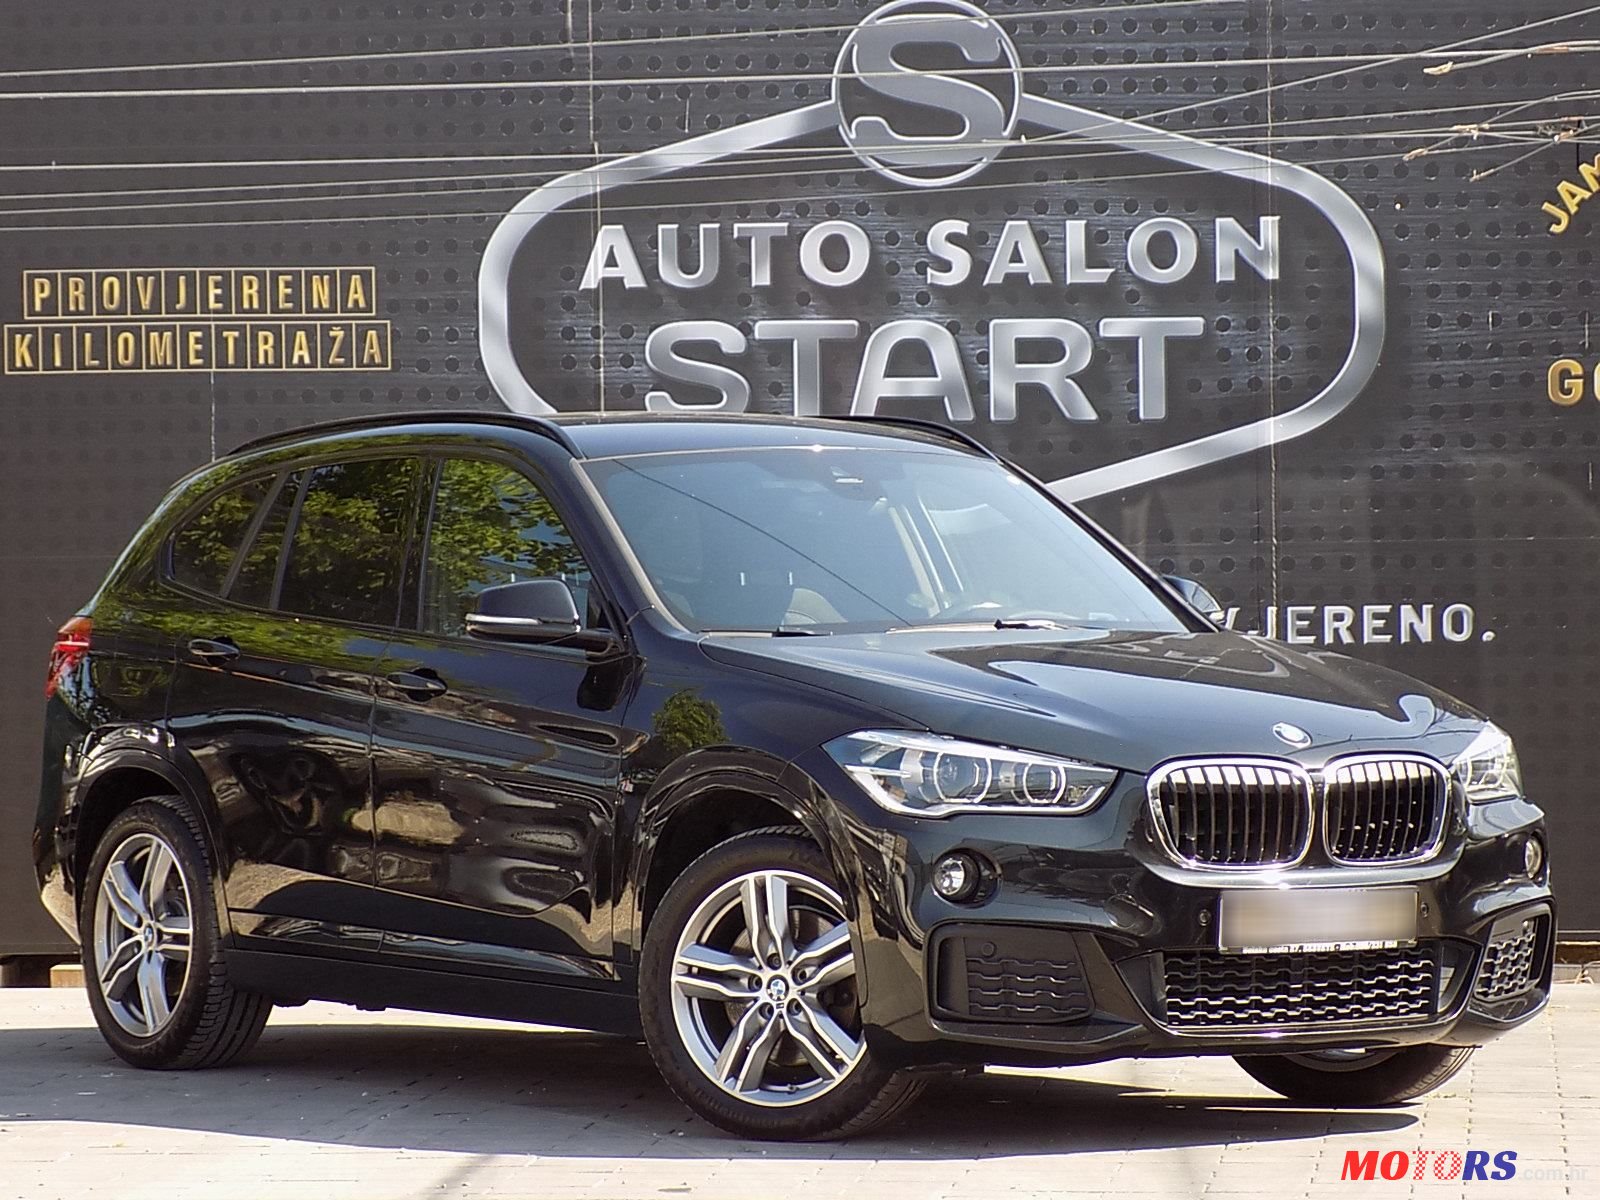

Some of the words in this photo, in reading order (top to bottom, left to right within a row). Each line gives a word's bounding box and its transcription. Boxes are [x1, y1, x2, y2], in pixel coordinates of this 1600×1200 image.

[579, 220, 871, 290] AUTO
[926, 215, 1281, 287] SALON
[33, 275, 367, 312] PROVJERENA
[15, 326, 383, 368] KILOMETRAŽA
[645, 316, 1205, 421] START
[1547, 358, 1600, 406] G
